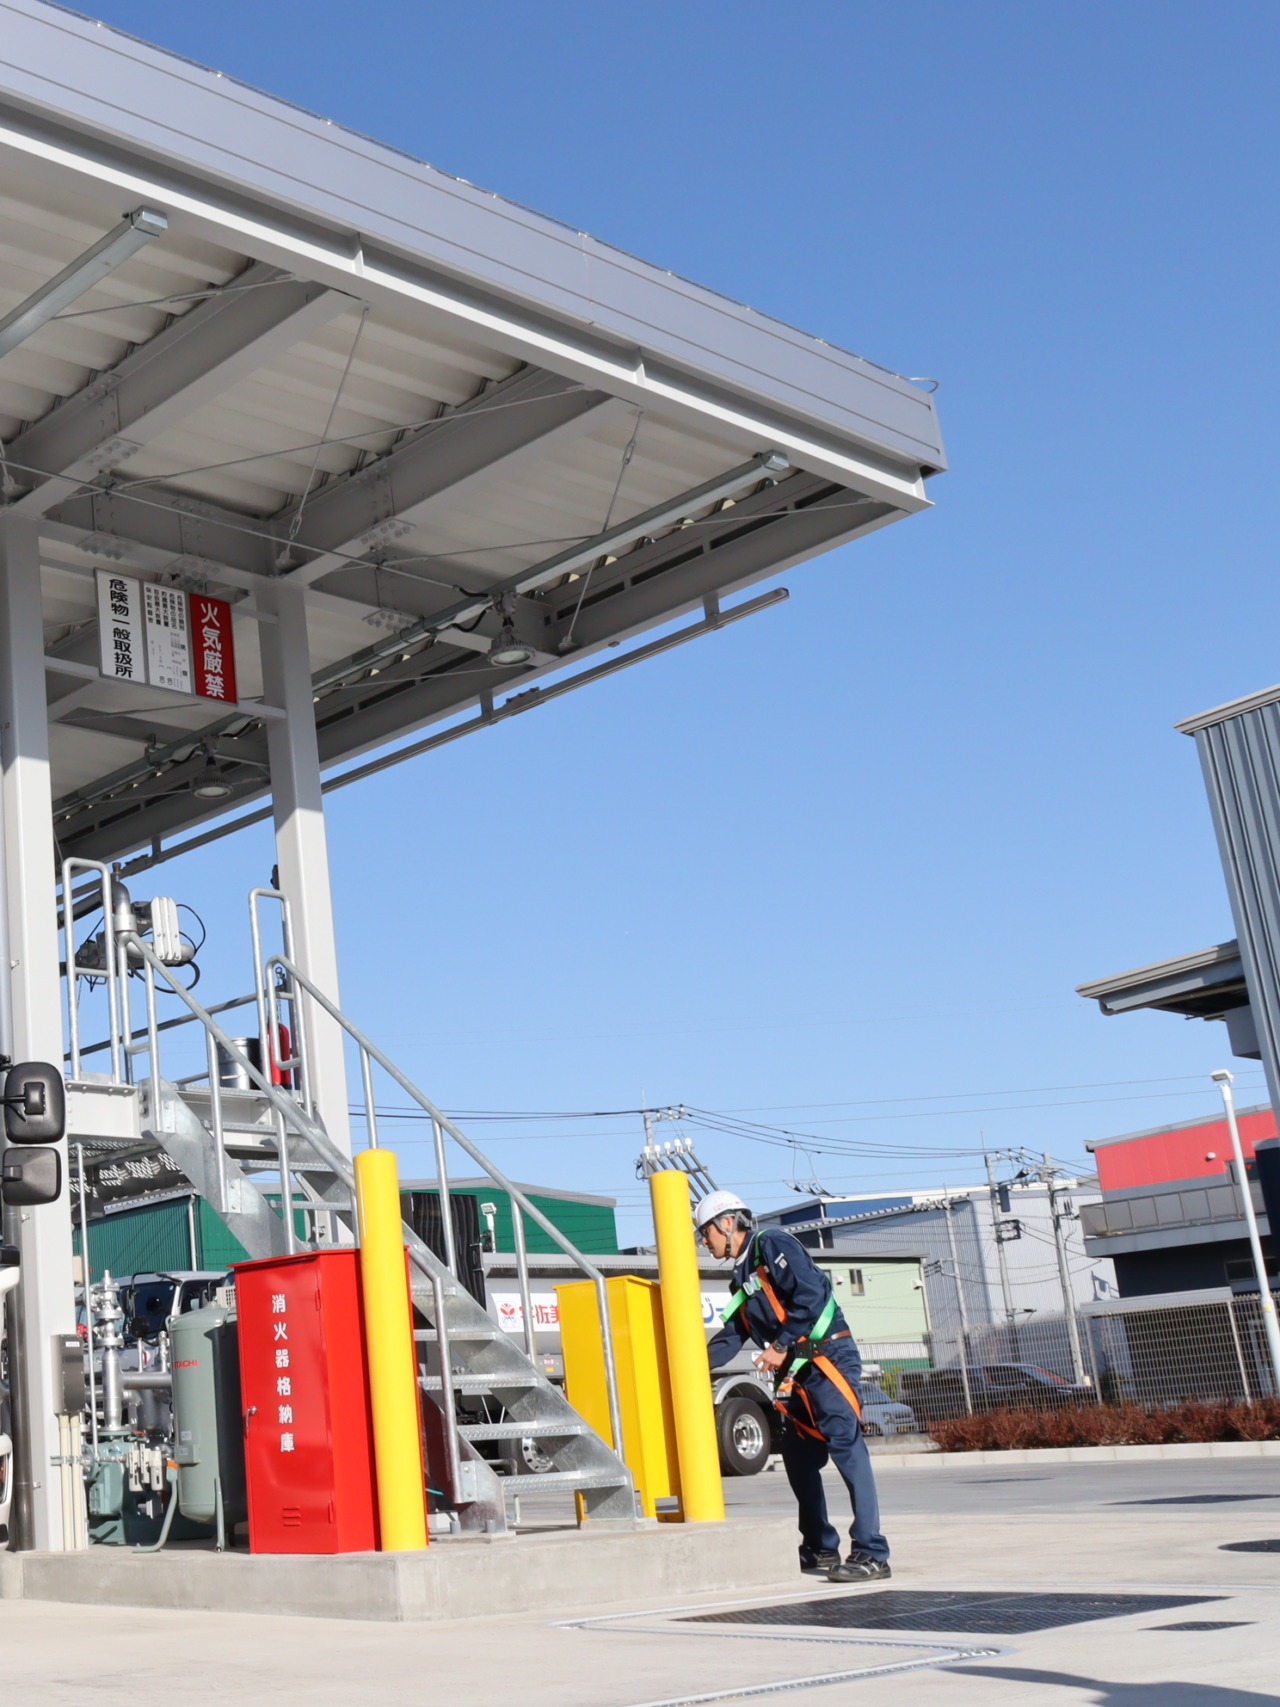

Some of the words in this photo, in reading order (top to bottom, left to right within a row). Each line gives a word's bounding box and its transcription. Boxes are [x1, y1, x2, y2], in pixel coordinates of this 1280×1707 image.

[109, 578, 134, 679] 危険物一般取扱所
[200, 601, 225, 699] 火気厳禁
[272, 1294, 295, 1452] 消火器格納庫
